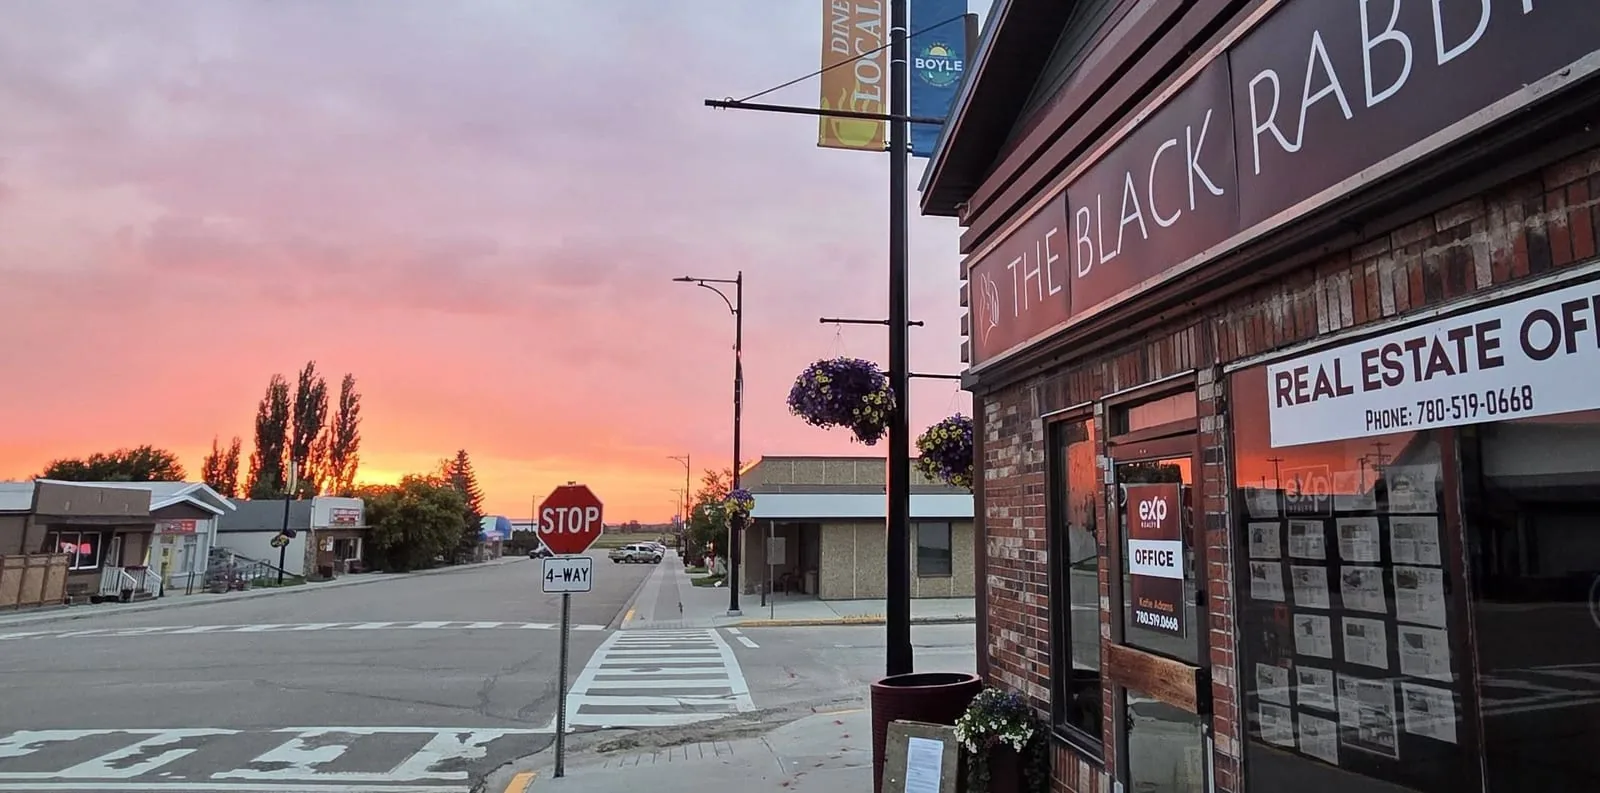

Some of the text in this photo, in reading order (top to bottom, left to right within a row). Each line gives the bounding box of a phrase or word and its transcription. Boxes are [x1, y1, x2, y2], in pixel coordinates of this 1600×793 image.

[831, 0, 850, 56] DINE
[855, 0, 881, 102] LOCAL
[915, 58, 963, 72] BOYLE
[1007, 226, 1062, 318] THE
[1075, 108, 1224, 279] BLACK
[1275, 357, 1354, 408] REAL
[1361, 318, 1504, 392] ESTATE
[1416, 385, 1533, 424] 780-519-0668
[541, 506, 600, 534] STOP
[1135, 549, 1174, 567] OFFICE
[545, 567, 588, 583] 4-WAY
[1135, 610, 1179, 631] 780.519.0668
